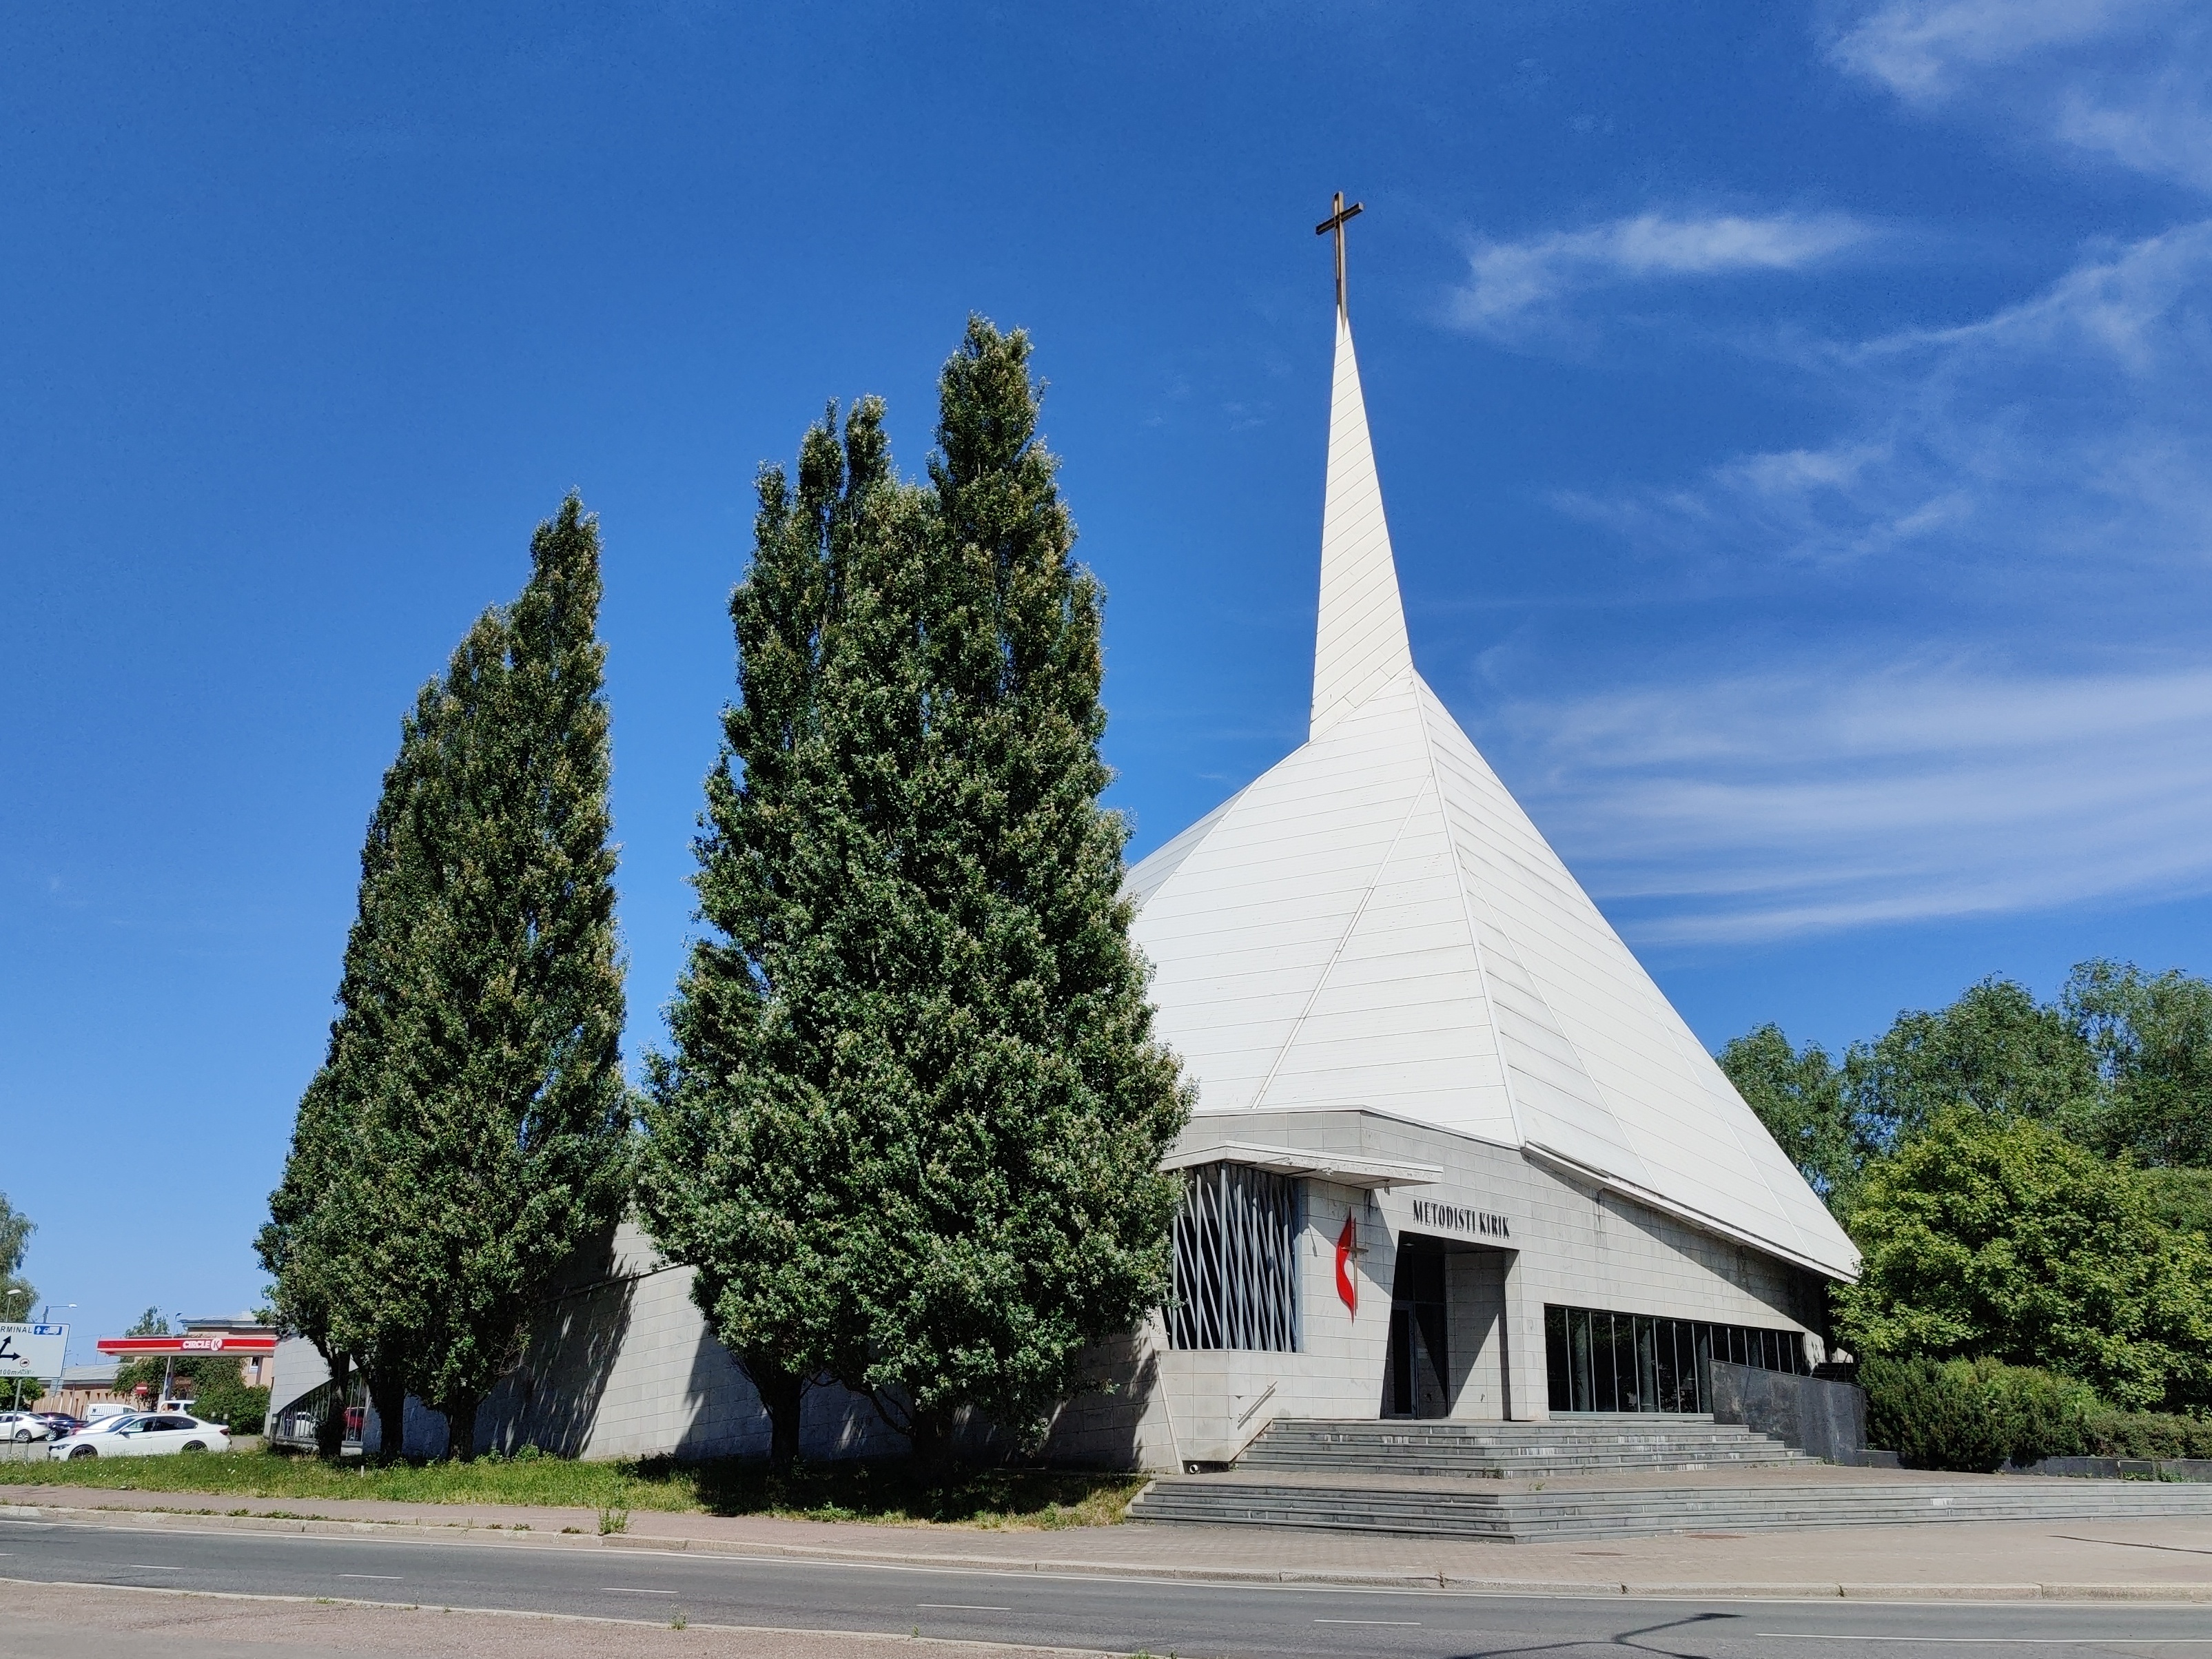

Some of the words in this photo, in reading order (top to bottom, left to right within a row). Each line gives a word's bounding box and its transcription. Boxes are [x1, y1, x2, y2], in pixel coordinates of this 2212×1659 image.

[1413, 1199, 1475, 1234] METODISTI
[1479, 1213, 1510, 1239] KIRIK
[183, 1340, 211, 1349] CIRCLE
[212, 1339, 221, 1350] K
